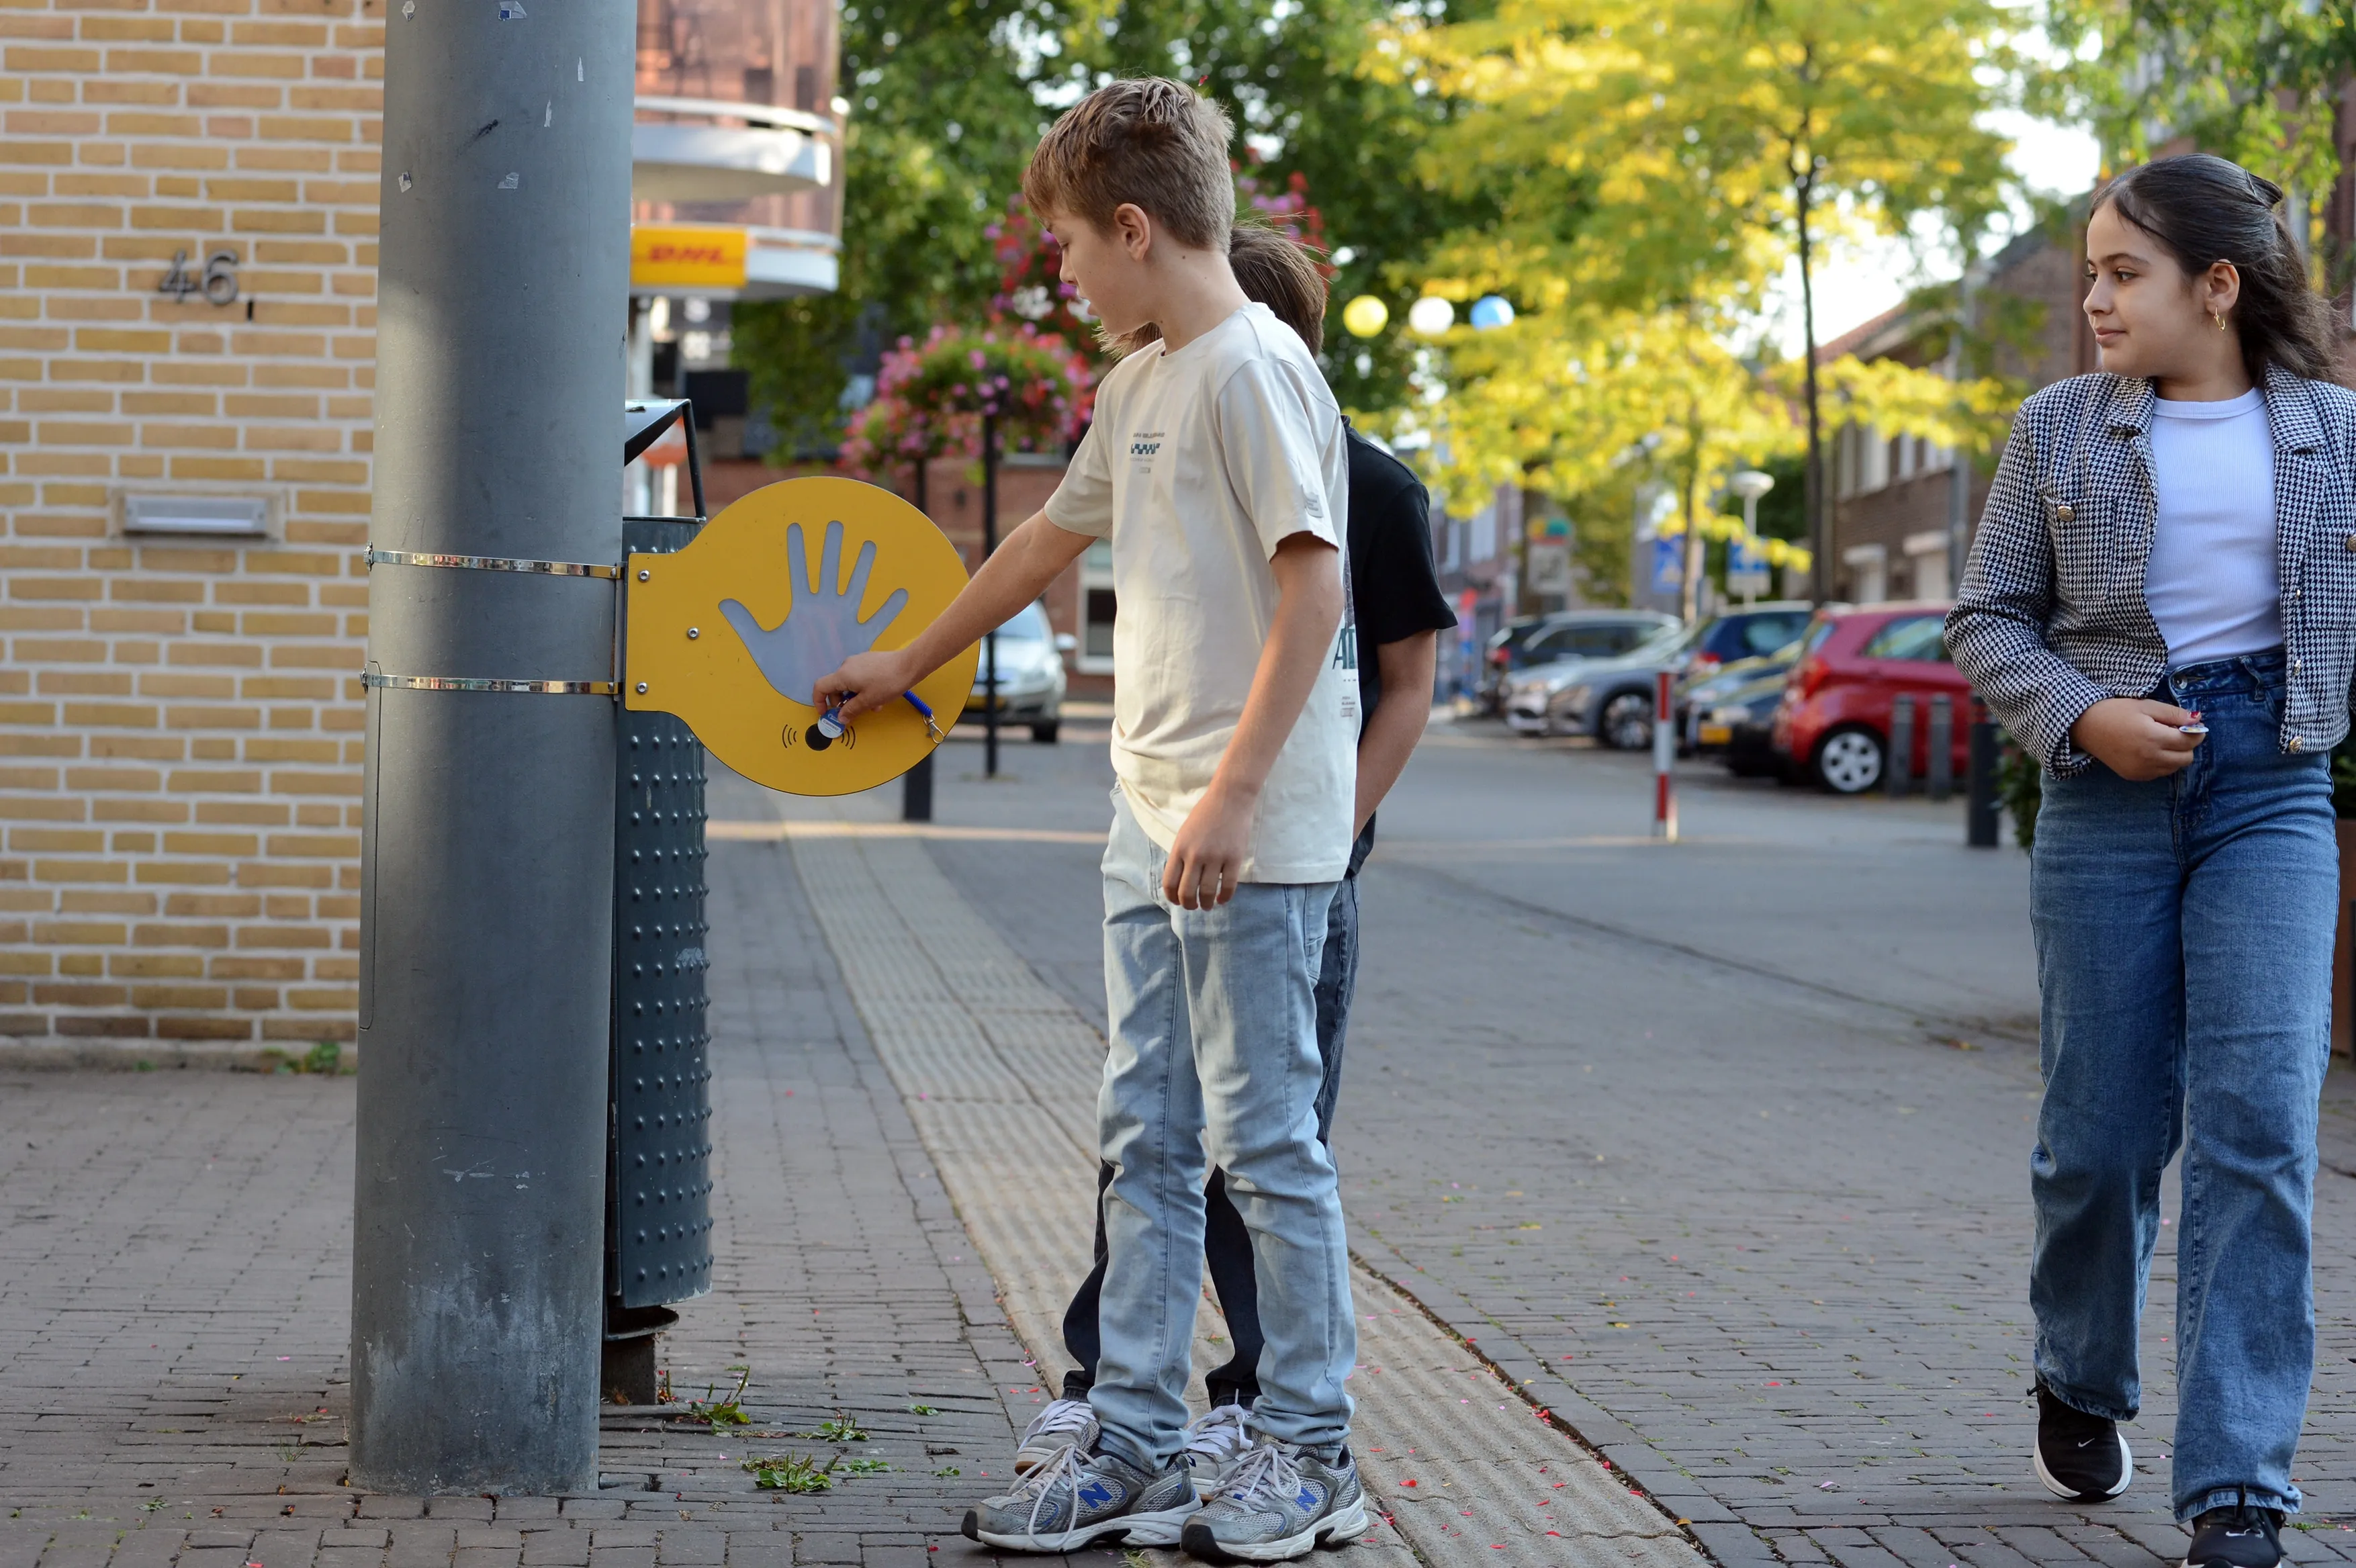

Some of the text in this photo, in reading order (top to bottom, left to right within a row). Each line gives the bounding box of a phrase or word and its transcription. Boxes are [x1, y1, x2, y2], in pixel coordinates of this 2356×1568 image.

[158, 249, 238, 306] 46
[1078, 1481, 1114, 1510] N
[1295, 1486, 1318, 1512] N
